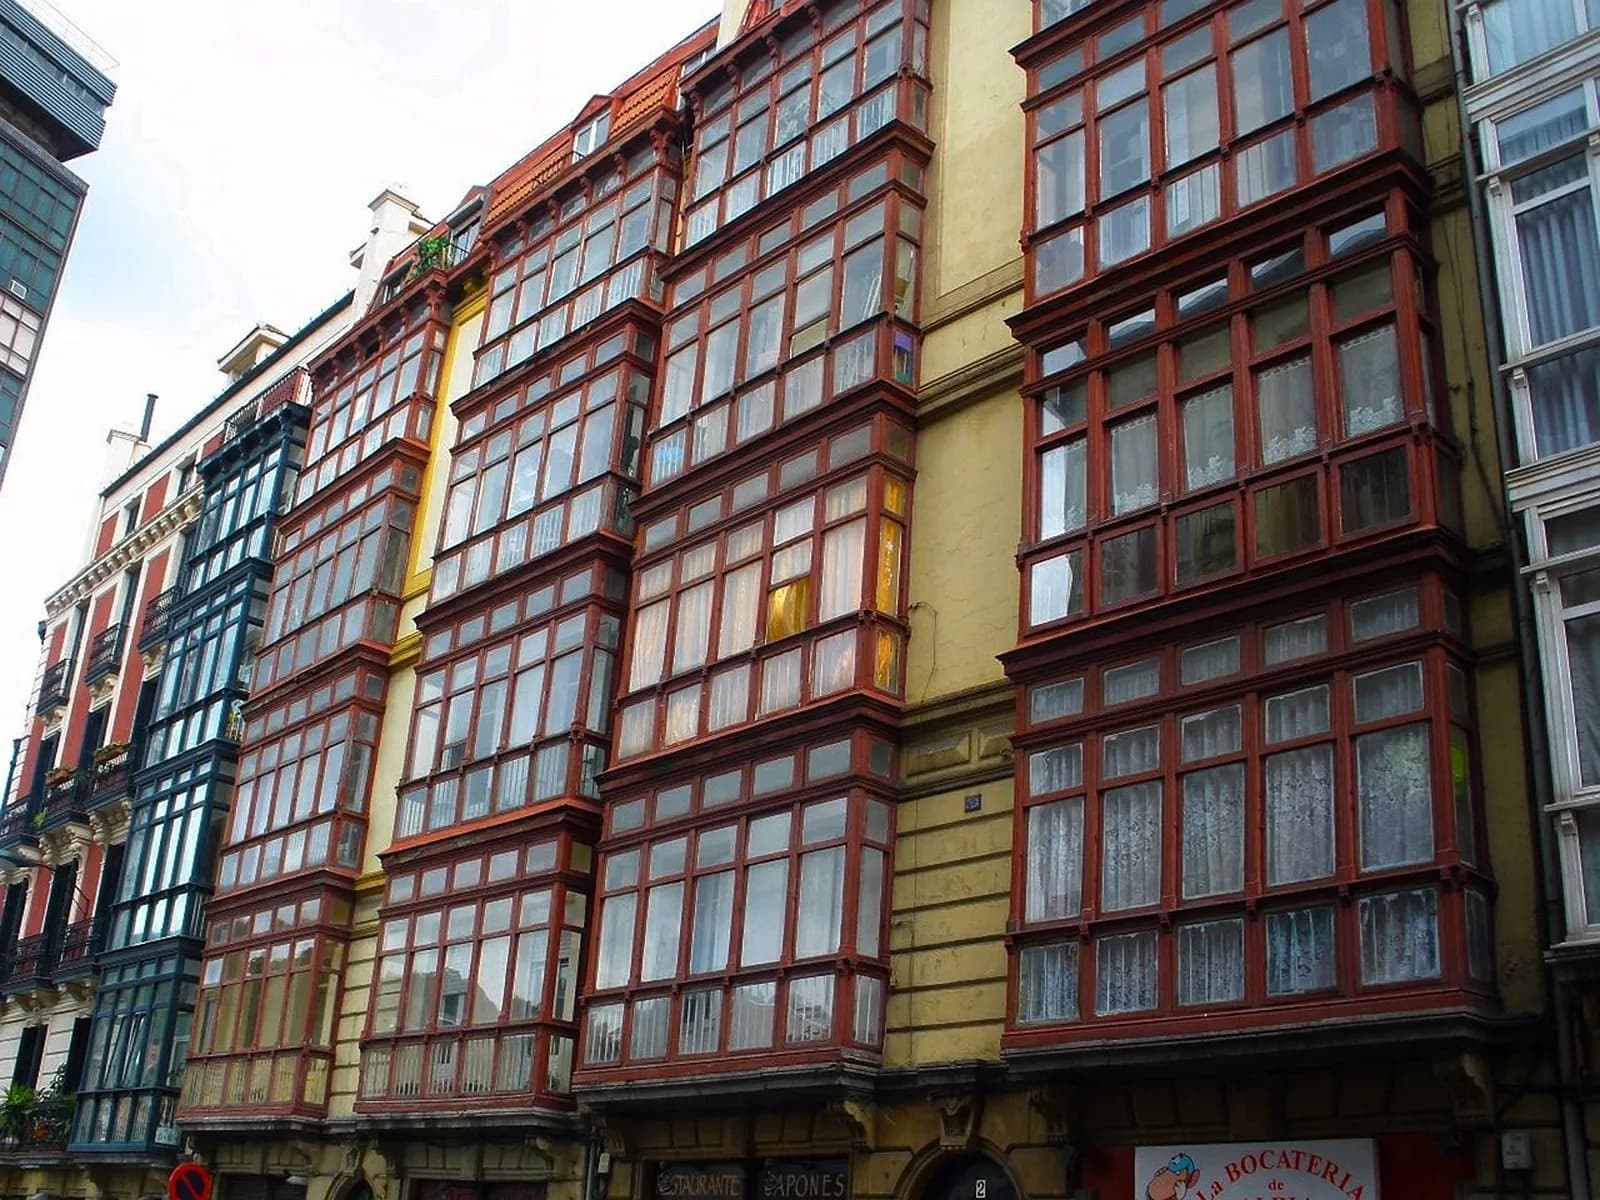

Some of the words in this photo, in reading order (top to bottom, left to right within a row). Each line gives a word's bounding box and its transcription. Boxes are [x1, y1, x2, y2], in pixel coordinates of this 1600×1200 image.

[1196, 1179, 1223, 1200] La
[1224, 1149, 1366, 1200] BOCATERIA
[1268, 1178, 1285, 1191] de
[657, 1173, 742, 1197] STAURANTE
[977, 1180, 985, 1197] 2
